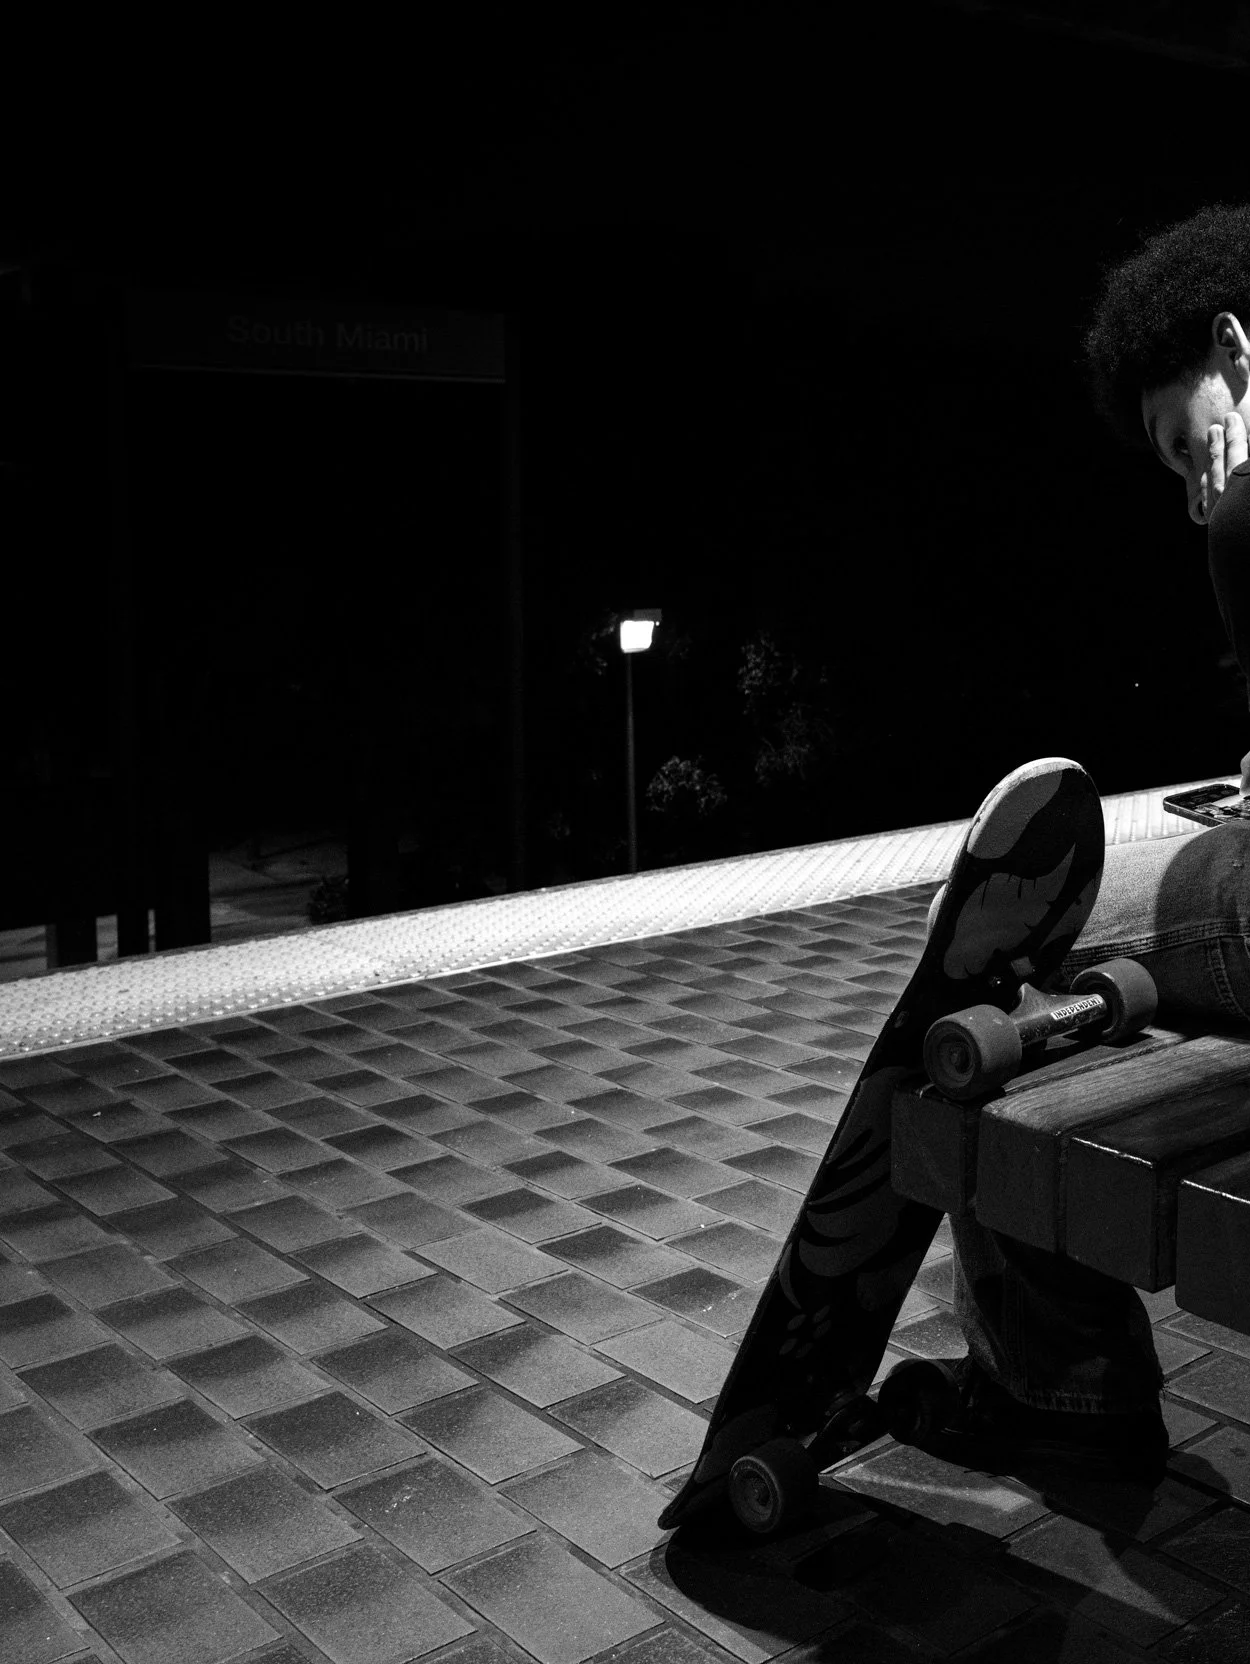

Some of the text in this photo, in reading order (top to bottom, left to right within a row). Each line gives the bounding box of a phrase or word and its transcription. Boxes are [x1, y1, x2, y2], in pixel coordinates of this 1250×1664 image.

[226, 314, 430, 352] South Miami
[1053, 997, 1101, 1019] INDEPENDENT
